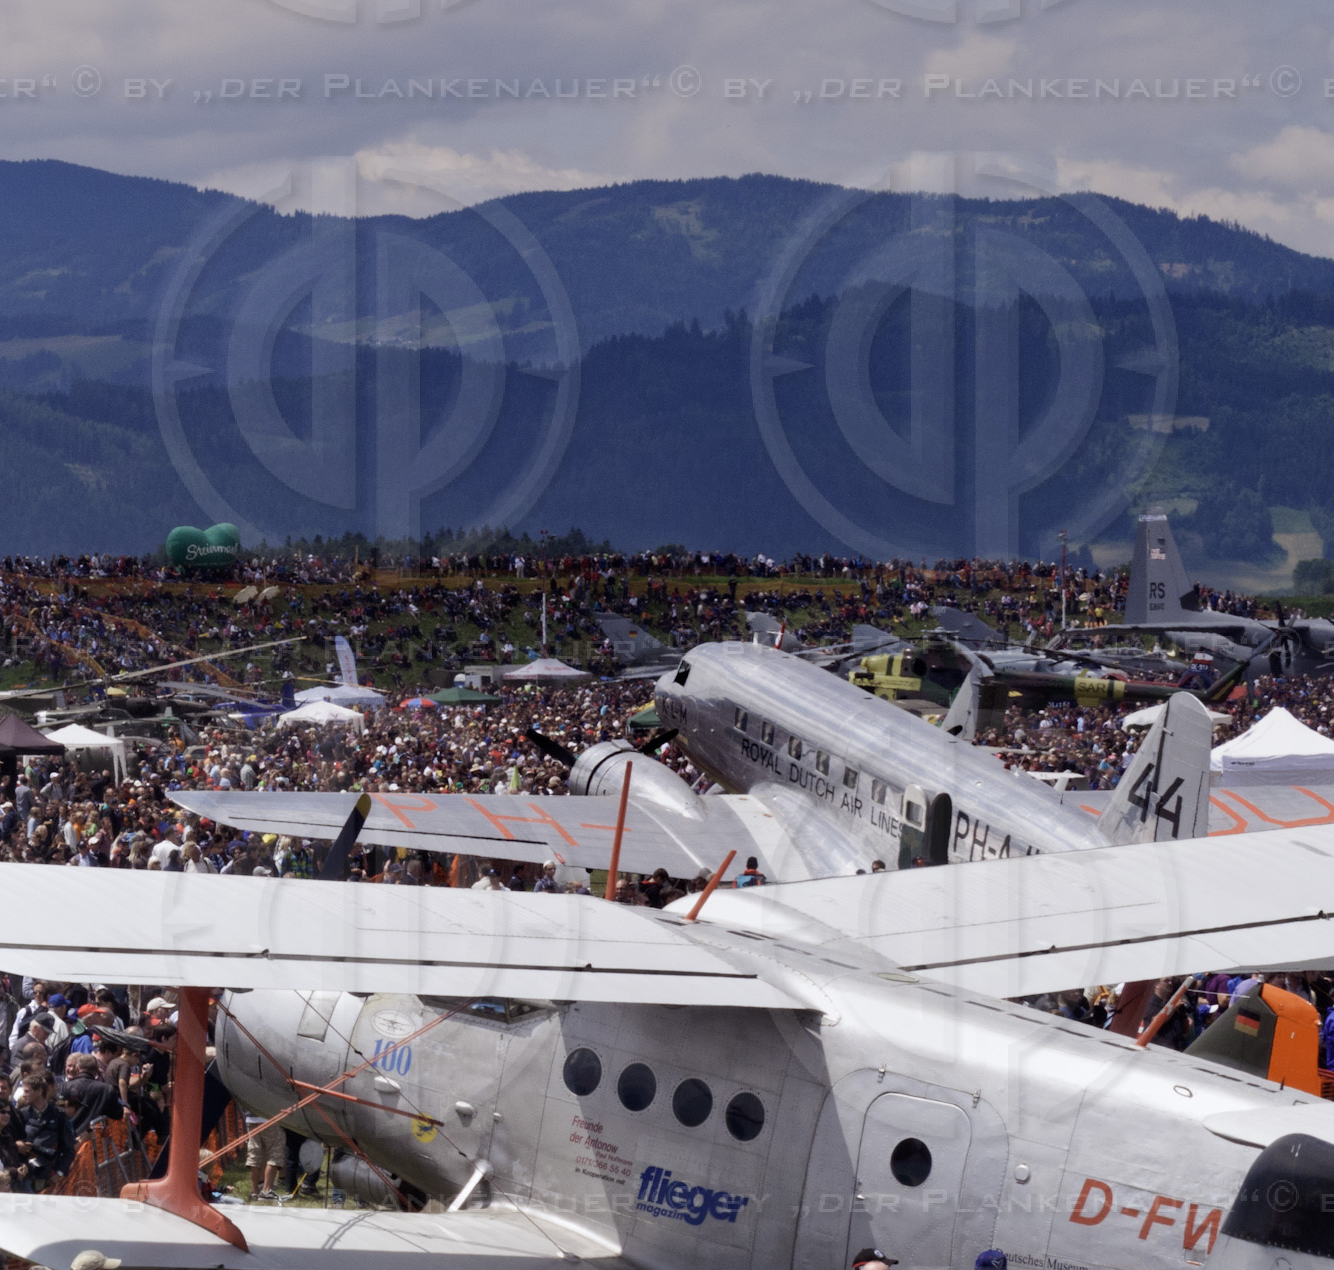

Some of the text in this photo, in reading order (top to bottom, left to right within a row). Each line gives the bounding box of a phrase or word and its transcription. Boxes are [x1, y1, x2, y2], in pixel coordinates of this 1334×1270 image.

[1149, 582, 1165, 600] RS
[1078, 682, 1106, 693] SAR
[740, 738, 782, 776] ROYAL
[789, 762, 835, 803] DUTCH
[841, 792, 863, 818] AIR
[1127, 762, 1186, 839] 44
[373, 1038, 412, 1076] 100
[572, 1115, 603, 1134] Freunde
[569, 1131, 619, 1154] der Antonow
[581, 1168, 615, 1183] Kooperation
[609, 1165, 620, 1173] 55
[620, 1168, 632, 1177] 40
[638, 1165, 749, 1226] flieger
[636, 1202, 684, 1221] magazin
